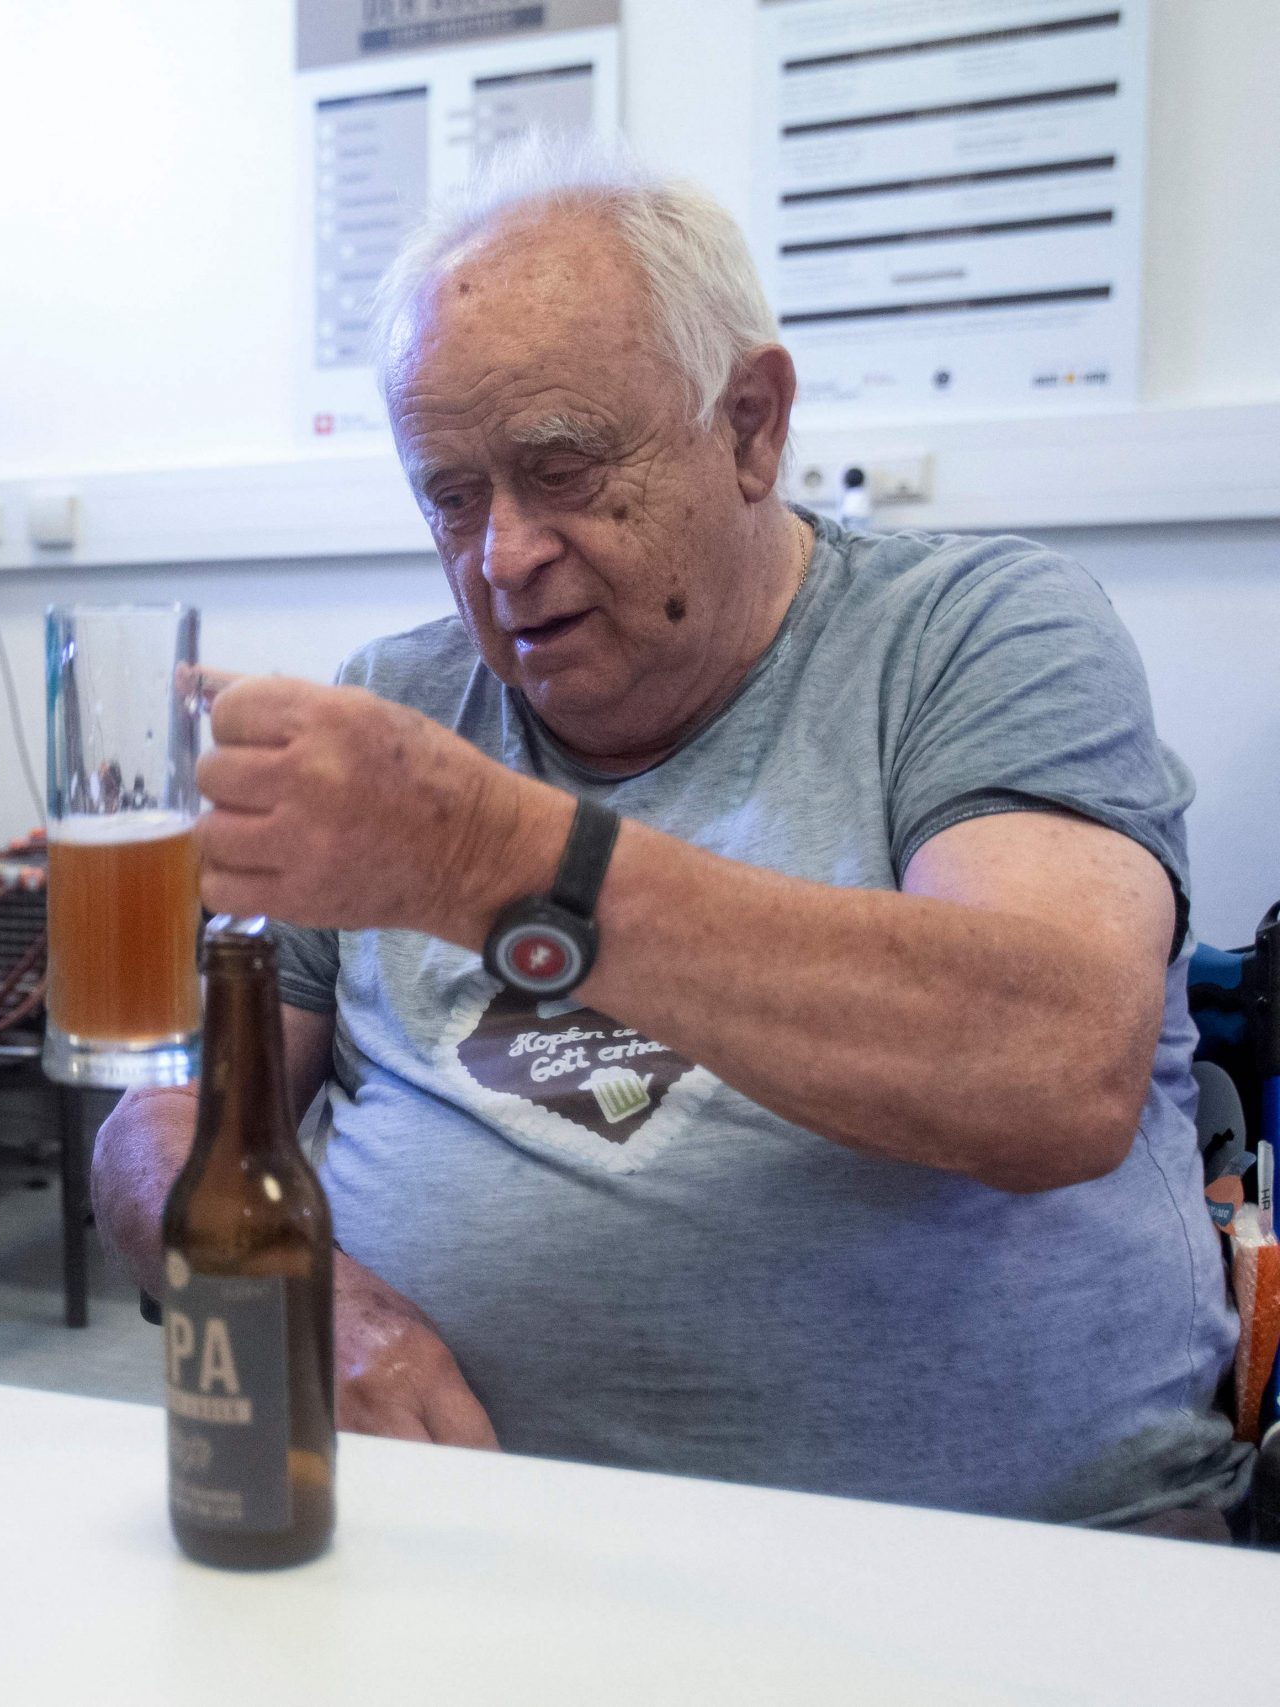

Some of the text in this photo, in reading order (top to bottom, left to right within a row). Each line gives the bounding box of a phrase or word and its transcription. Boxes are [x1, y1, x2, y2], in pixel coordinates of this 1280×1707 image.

[508, 1026, 605, 1057] Hopfen
[530, 1039, 670, 1083] Gott erha
